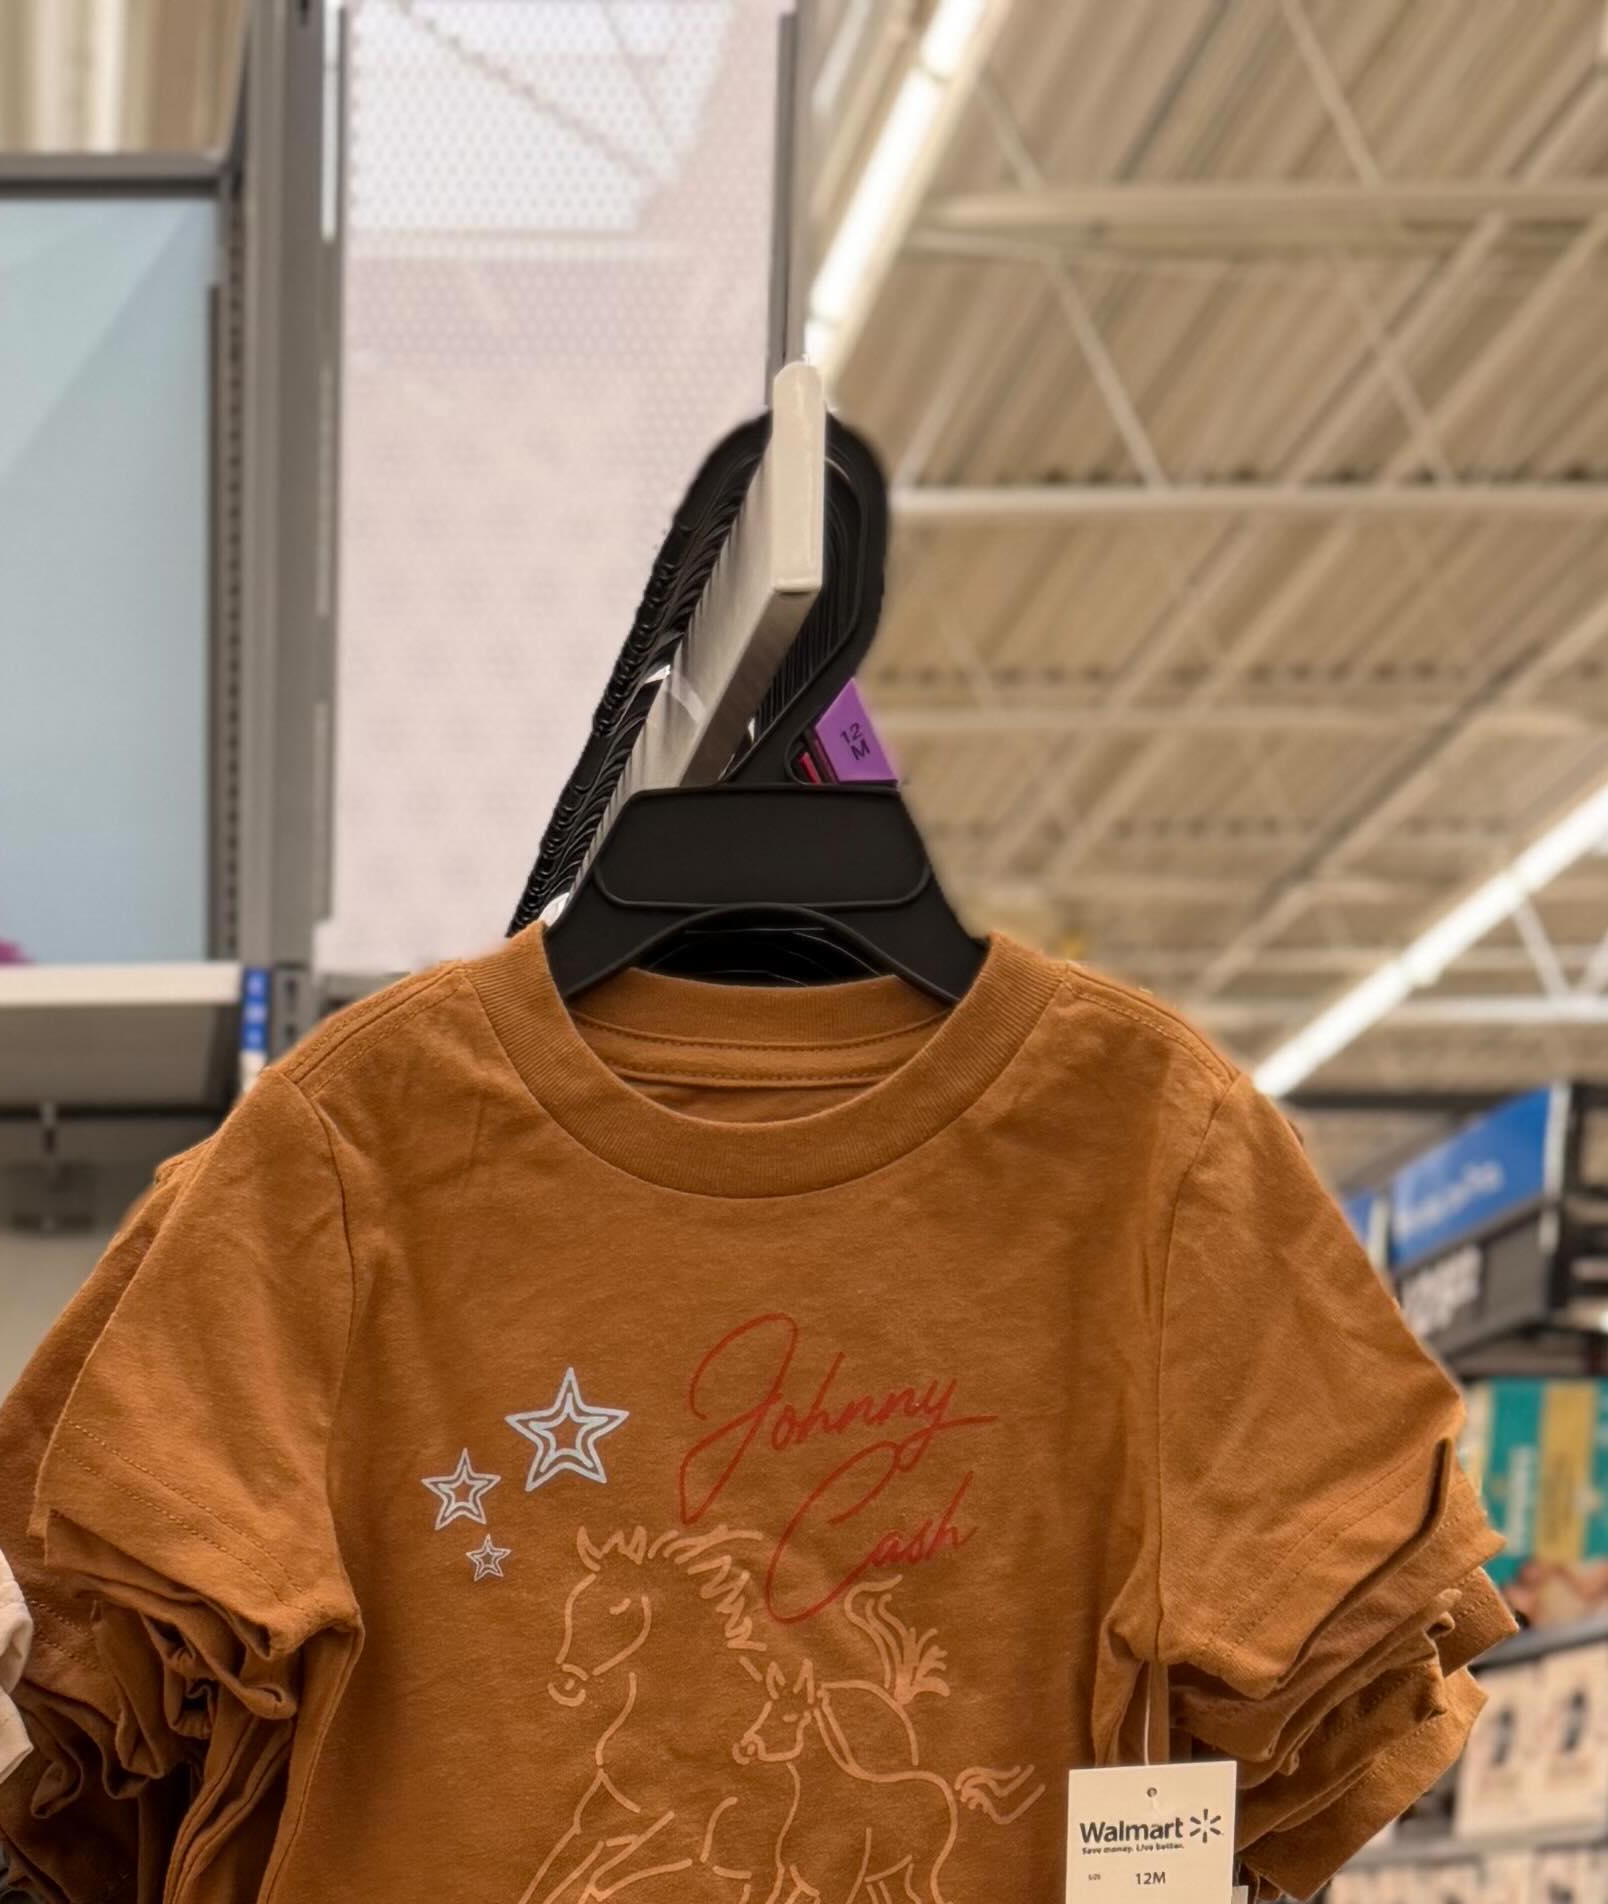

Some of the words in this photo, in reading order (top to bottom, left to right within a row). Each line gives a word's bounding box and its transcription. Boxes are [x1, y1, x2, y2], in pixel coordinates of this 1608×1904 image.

[840, 721, 863, 744] 12
[850, 738, 871, 761] M
[679, 1312, 998, 1525] Johnny
[765, 1440, 977, 1624] Cash
[1080, 1817, 1184, 1844] Walmart
[1081, 1846, 1102, 1855] Save
[1135, 1871, 1166, 1885] 12M
